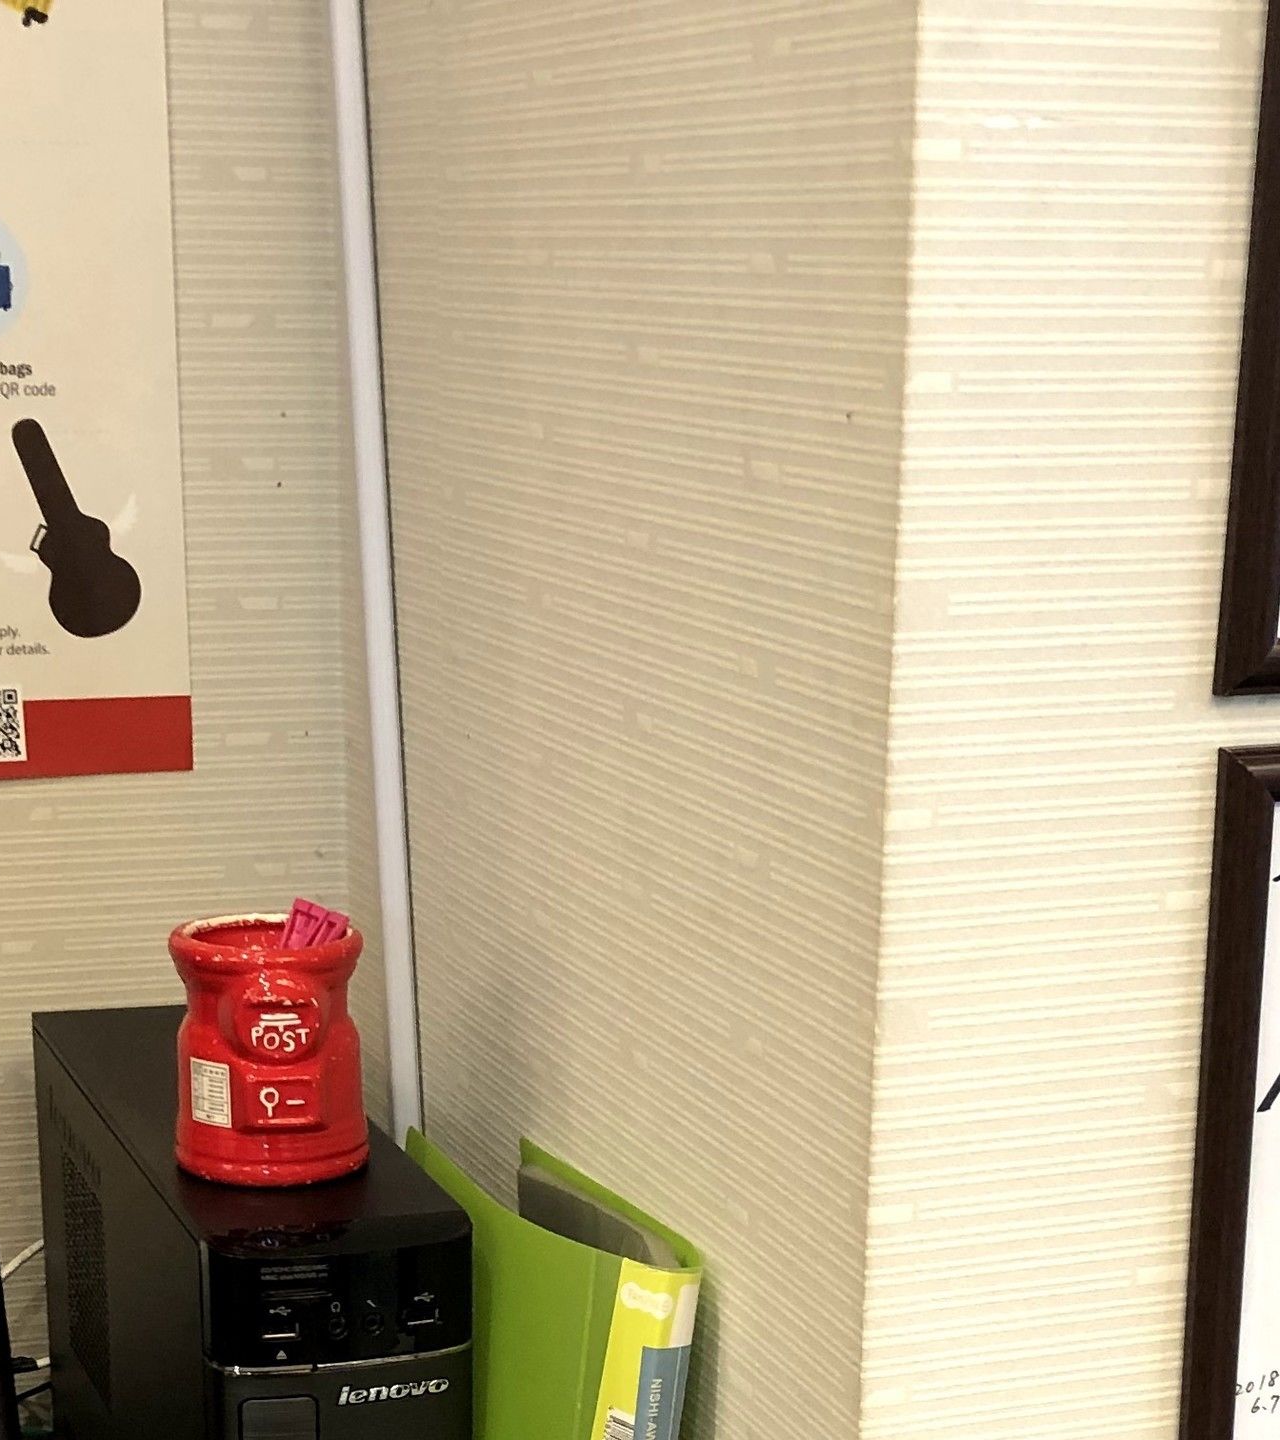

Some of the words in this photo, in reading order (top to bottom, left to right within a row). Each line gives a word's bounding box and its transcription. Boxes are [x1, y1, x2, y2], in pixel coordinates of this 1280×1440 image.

[0, 362, 32, 379] bags
[0, 384, 20, 399] QR
[24, 384, 56, 397] code
[6, 642, 50, 657] details.
[251, 1026, 310, 1052] POST
[337, 1378, 449, 1406] lenovo
[1235, 1370, 1279, 1396] 2018
